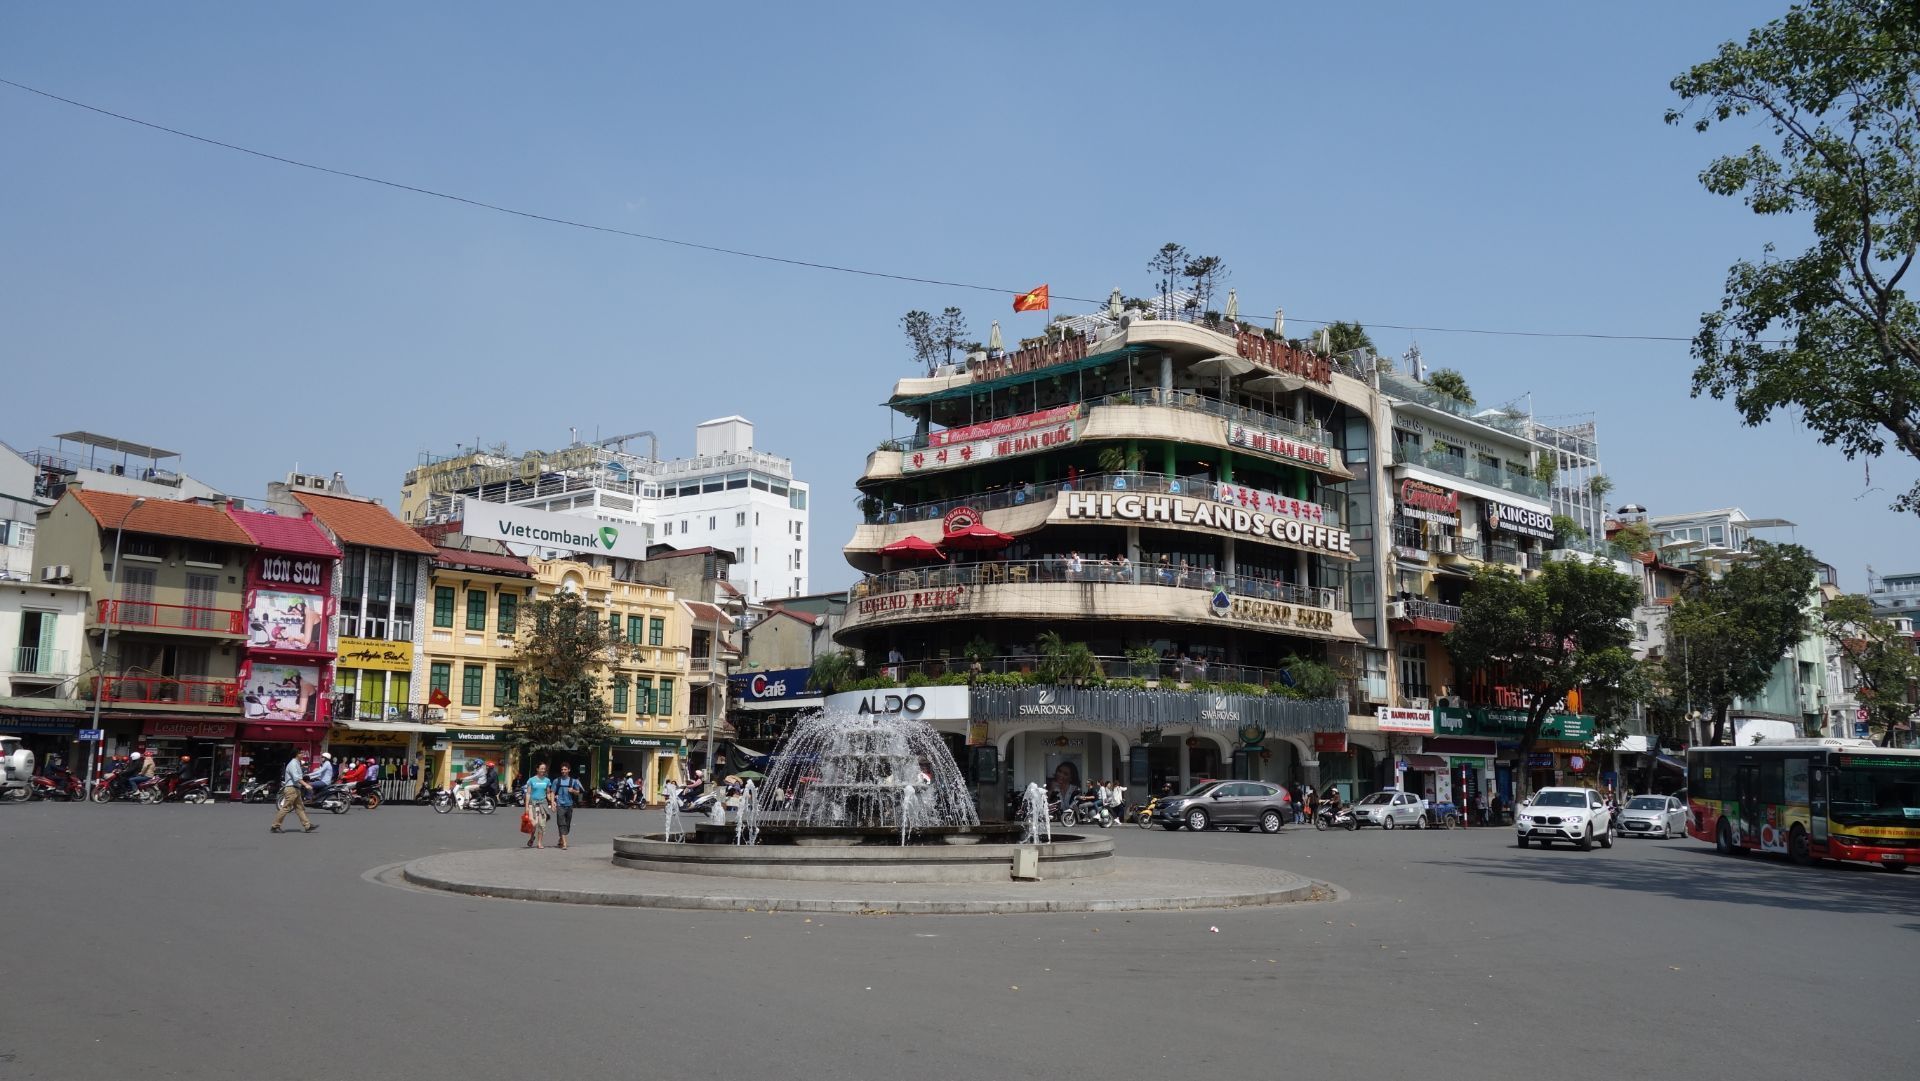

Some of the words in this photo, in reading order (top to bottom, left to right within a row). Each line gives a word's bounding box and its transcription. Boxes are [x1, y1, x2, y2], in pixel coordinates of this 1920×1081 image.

[944, 508, 978, 526] HIGHLANDS
[1068, 491, 1266, 536] HIGHLANDS
[1270, 518, 1351, 551] COFFEE
[1404, 507, 1426, 519] ITALIAN
[1426, 512, 1460, 526] RESTAURANT
[499, 519, 598, 548] Vietcombank
[1499, 521, 1518, 531] KOREAN
[1518, 525, 1527, 534] BBQ
[1528, 528, 1555, 540] RESTAURANT
[262, 556, 291, 582] NÓN
[293, 560, 321, 585] SƠN
[860, 594, 907, 616] LEGEND
[913, 589, 957, 609] BEER
[1231, 598, 1291, 621] LEGEND
[1297, 608, 1333, 628] BEER
[750, 674, 786, 698] Café
[858, 694, 926, 715] ALDO
[1019, 704, 1075, 715] SWAROVSKI
[1201, 710, 1240, 721] SWAROVSKI
[155, 721, 197, 734] Leather
[458, 732, 496, 740] Vietcombank
